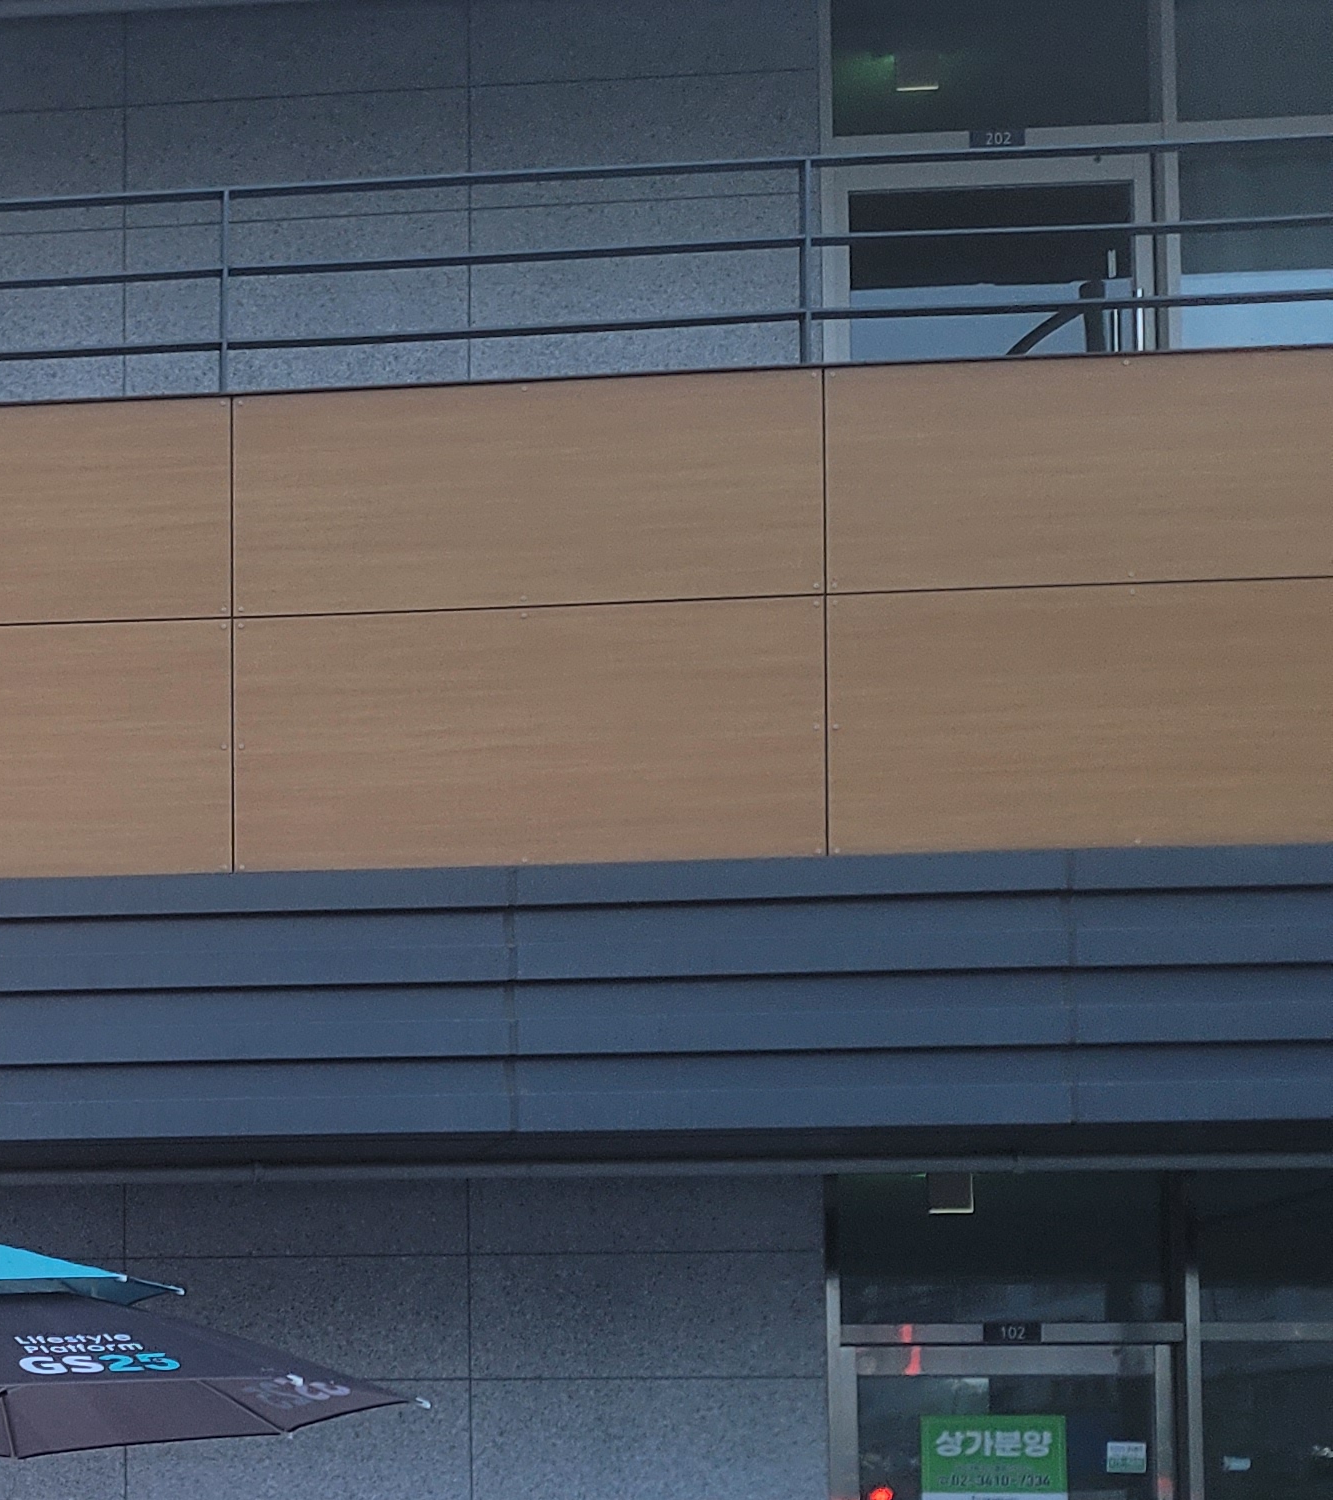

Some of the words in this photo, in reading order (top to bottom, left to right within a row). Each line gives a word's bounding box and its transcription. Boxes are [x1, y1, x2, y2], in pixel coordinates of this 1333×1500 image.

[985, 132, 1012, 145] 202
[14, 1333, 131, 1345] Lifestyle
[999, 1326, 1026, 1339] 102
[23, 1342, 143, 1354] Platform
[19, 1352, 181, 1375] GS25
[935, 1430, 1052, 1457] 상가분양
